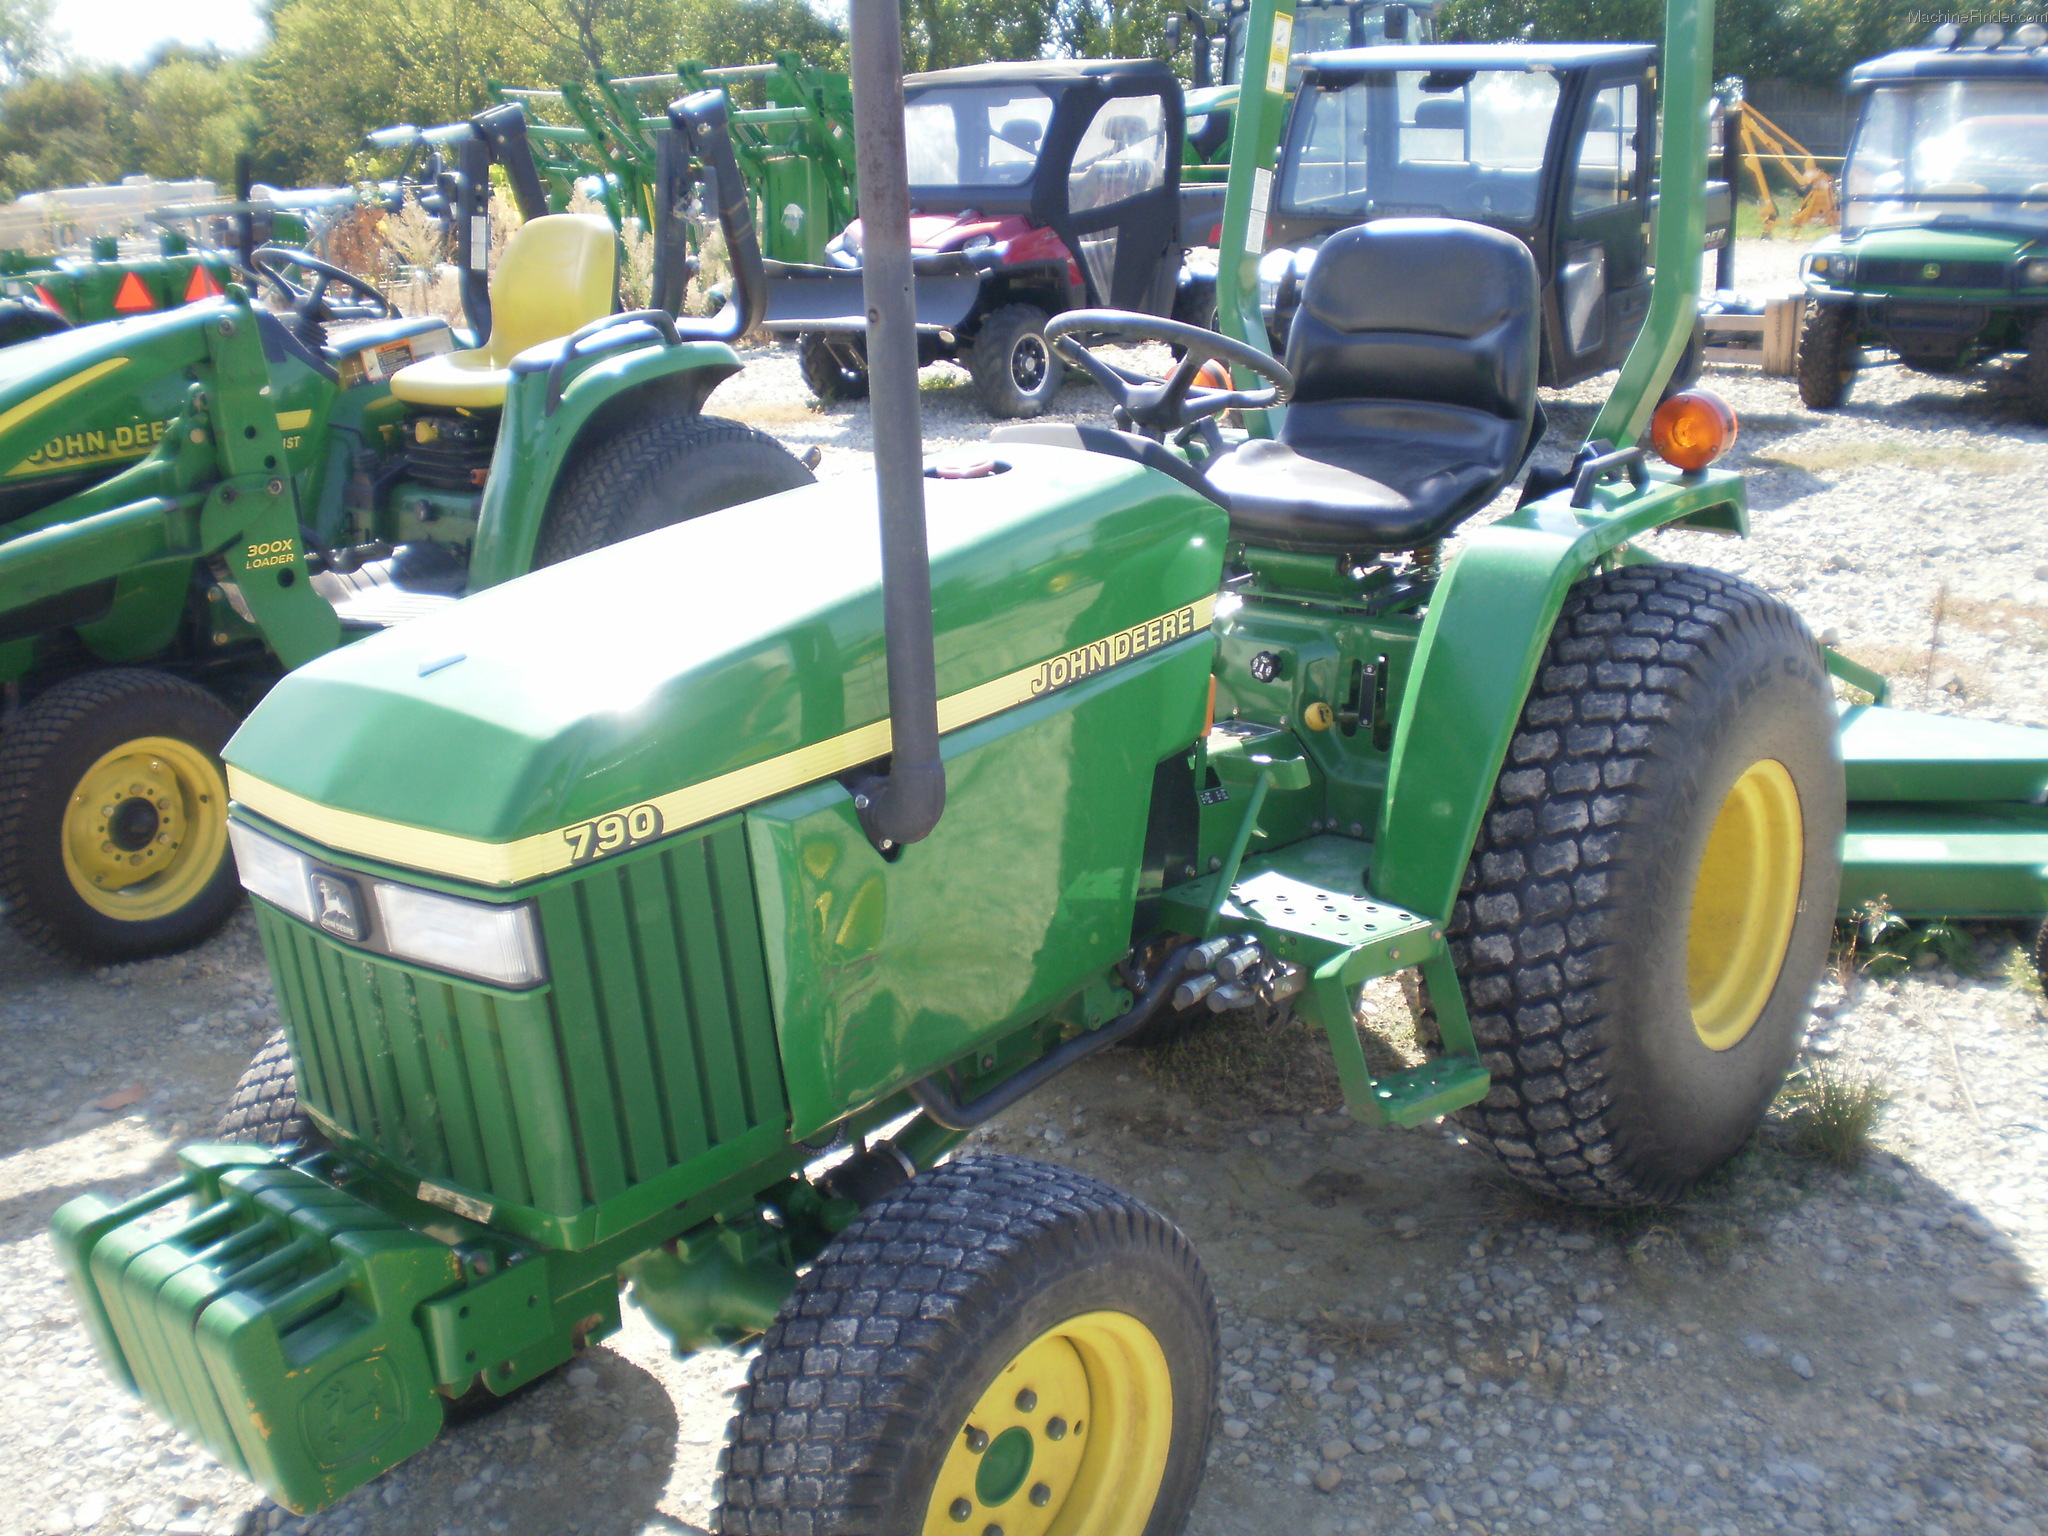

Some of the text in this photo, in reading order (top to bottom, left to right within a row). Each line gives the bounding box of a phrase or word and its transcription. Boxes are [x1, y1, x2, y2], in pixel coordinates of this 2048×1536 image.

[27, 430, 107, 463] JOHN
[246, 553, 294, 569] LOADER
[247, 538, 293, 558] 300X
[1031, 606, 1194, 695] JOHN DEERE
[563, 804, 665, 863] 790
